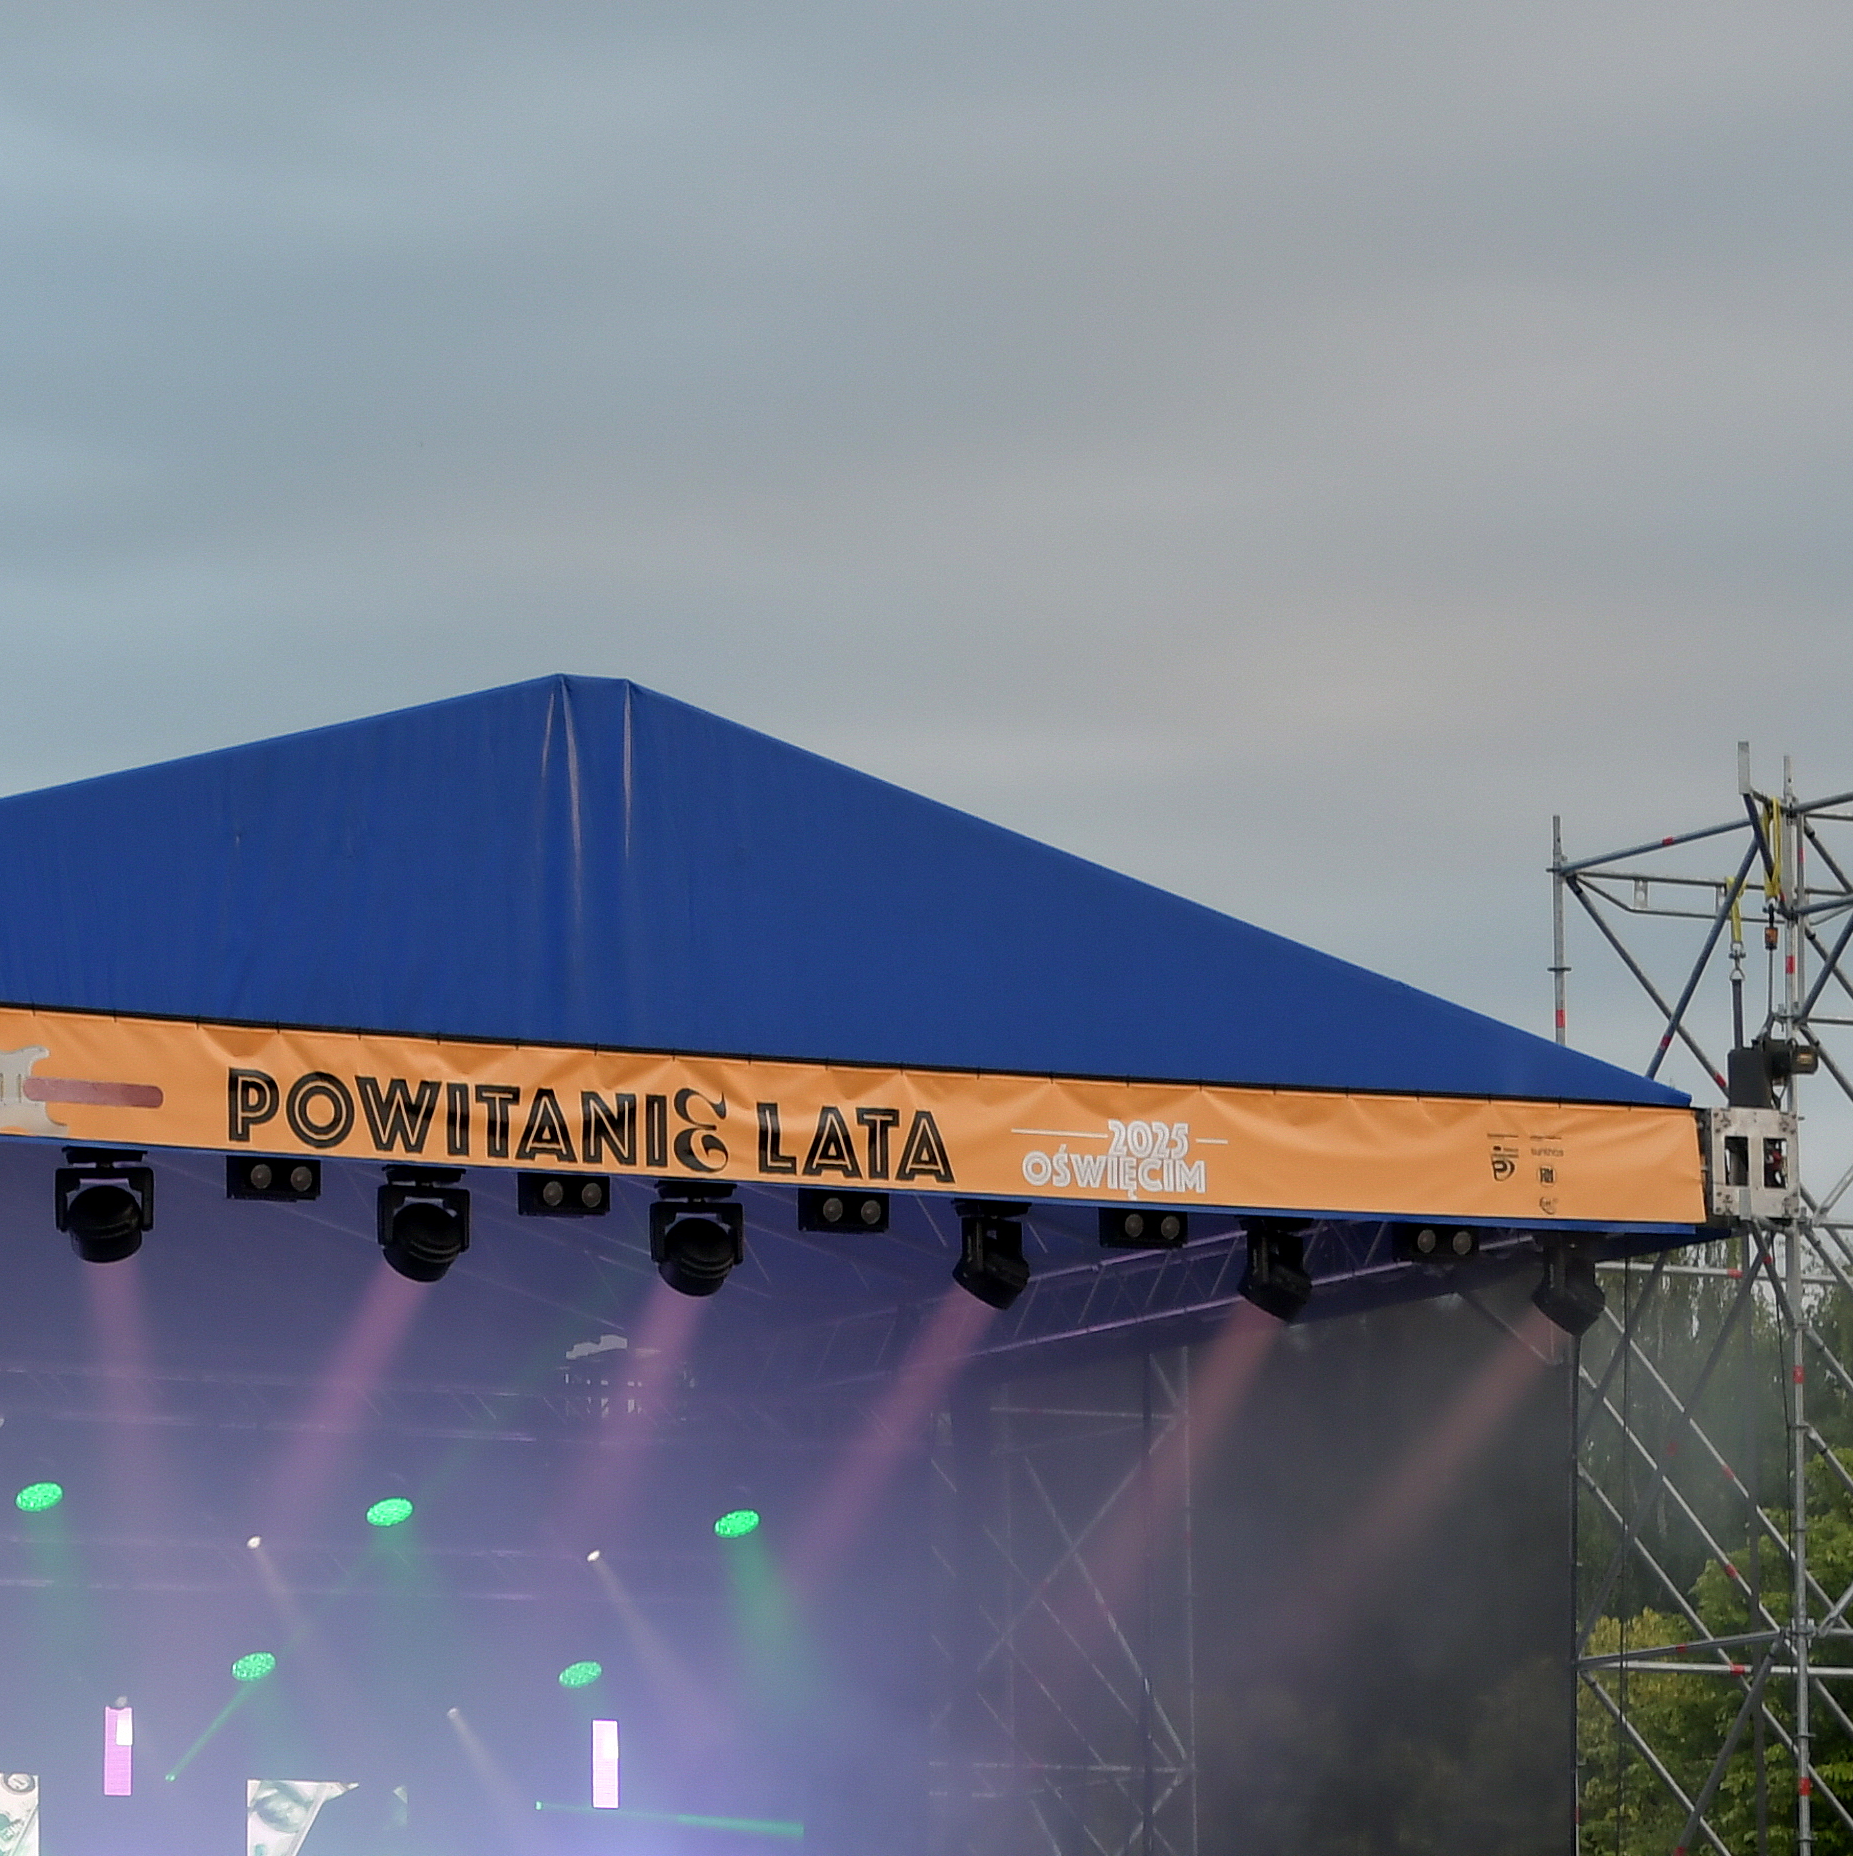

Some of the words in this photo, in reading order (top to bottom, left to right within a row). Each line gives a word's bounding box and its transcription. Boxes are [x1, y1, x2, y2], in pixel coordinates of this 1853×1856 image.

[227, 1067, 729, 1172] POWITANIE
[756, 1102, 955, 1183] LATA
[1108, 1119, 1189, 1159] 2025
[1022, 1144, 1206, 1200] OŚWIĘCIM
